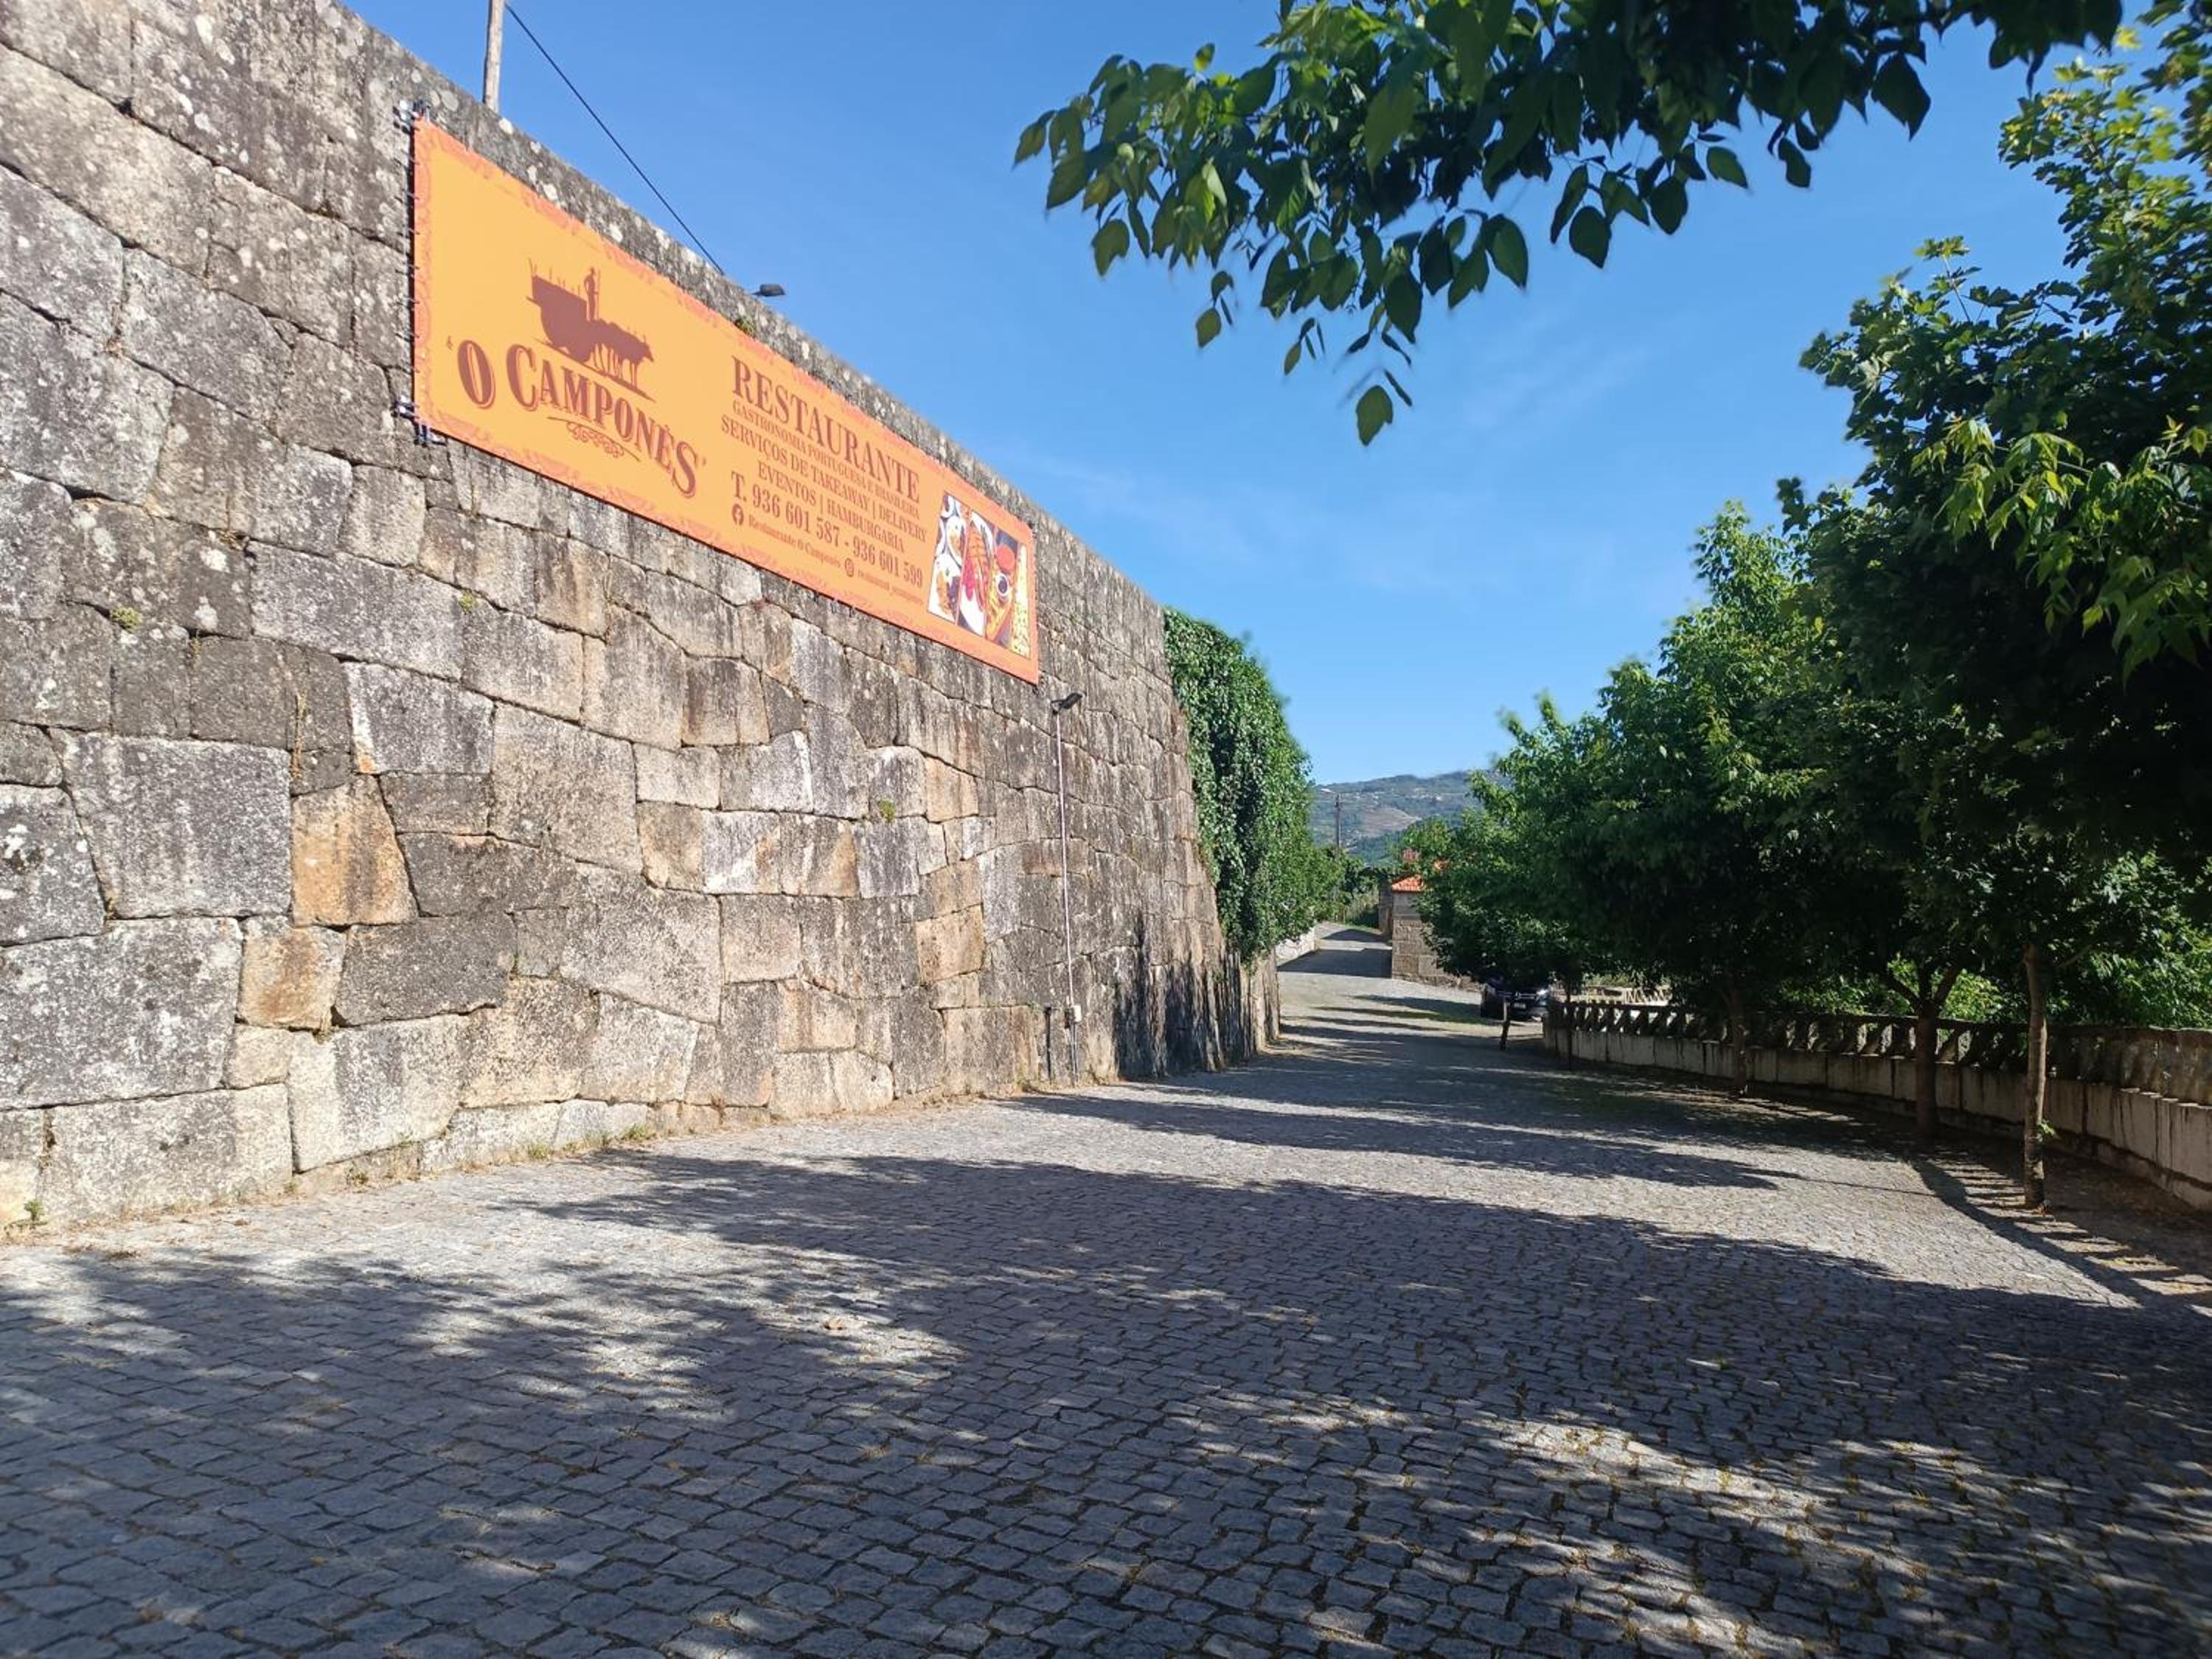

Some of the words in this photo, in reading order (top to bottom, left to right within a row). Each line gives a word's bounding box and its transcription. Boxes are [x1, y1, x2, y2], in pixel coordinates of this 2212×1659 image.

[457, 340, 495, 410] O
[720, 414, 788, 467] SERVIÇOS
[790, 452, 808, 479] DE
[810, 465, 868, 512] TAKEAWAY
[879, 504, 927, 544] DELIVERY
[731, 355, 919, 504] RESTAURANTE
[732, 399, 806, 455] GASTRONOMIA
[808, 444, 866, 489] PORTUGUESA
[731, 470, 747, 504] T.
[752, 483, 781, 518] 936
[785, 501, 811, 534] 601
[815, 516, 841, 547] 587
[852, 535, 876, 566] 936
[879, 549, 900, 577] 601
[903, 561, 923, 589] 599
[757, 459, 817, 507] EVENTOS
